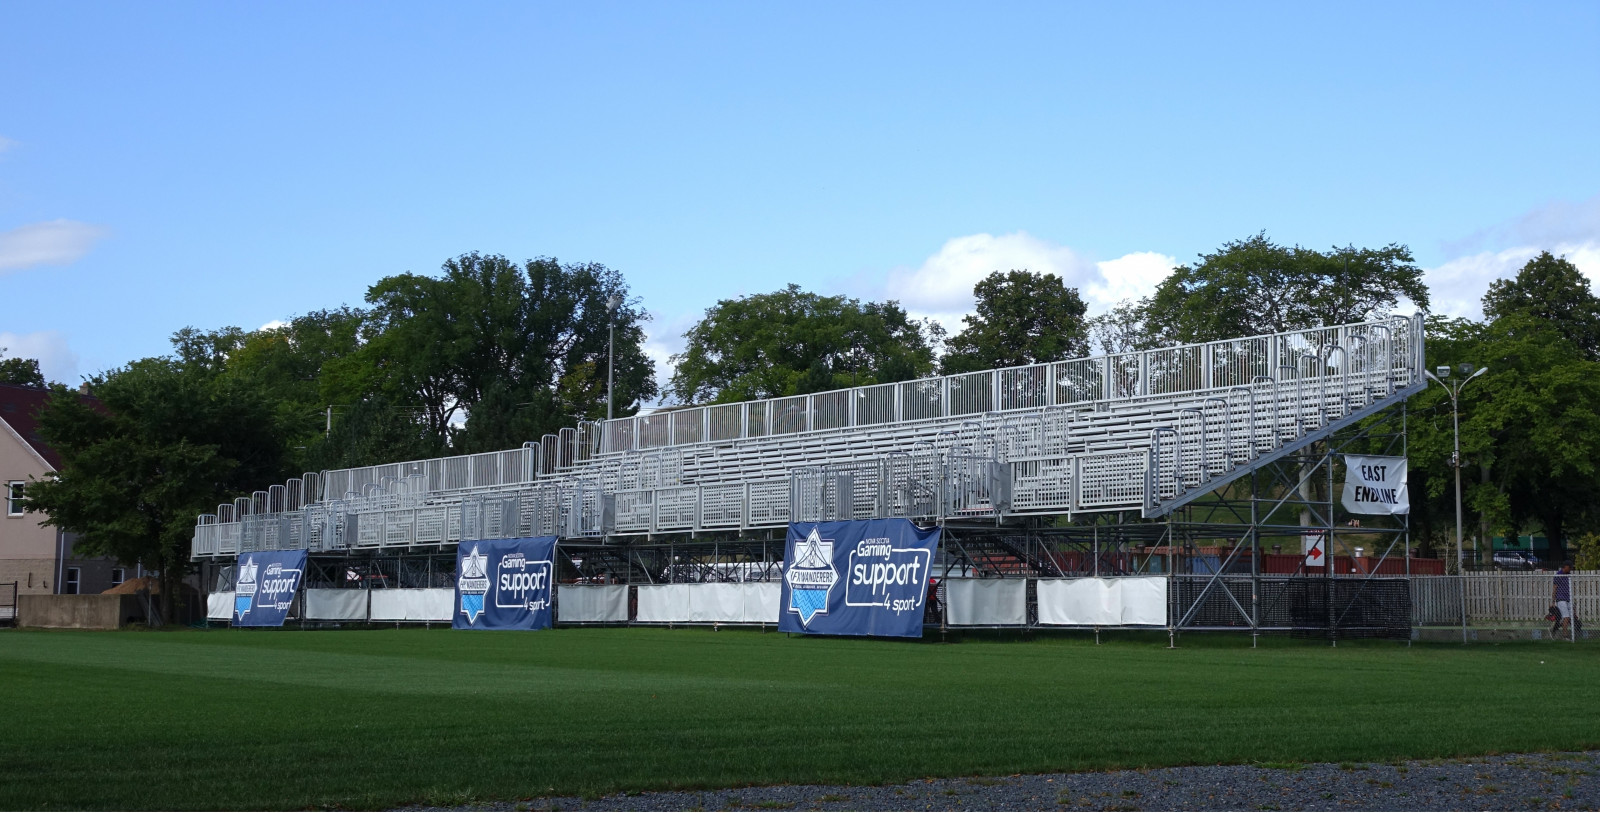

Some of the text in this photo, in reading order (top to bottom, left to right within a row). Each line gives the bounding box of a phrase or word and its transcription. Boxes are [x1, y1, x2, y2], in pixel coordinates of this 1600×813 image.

[1361, 465, 1387, 482] EAST
[857, 541, 892, 561] Gaming
[502, 555, 525, 571] Gaming
[501, 566, 546, 599] support
[801, 571, 834, 583] WANDERERS
[853, 556, 920, 595] support
[262, 574, 295, 600] support
[523, 597, 528, 610] 4
[883, 593, 915, 616] 4 sport
